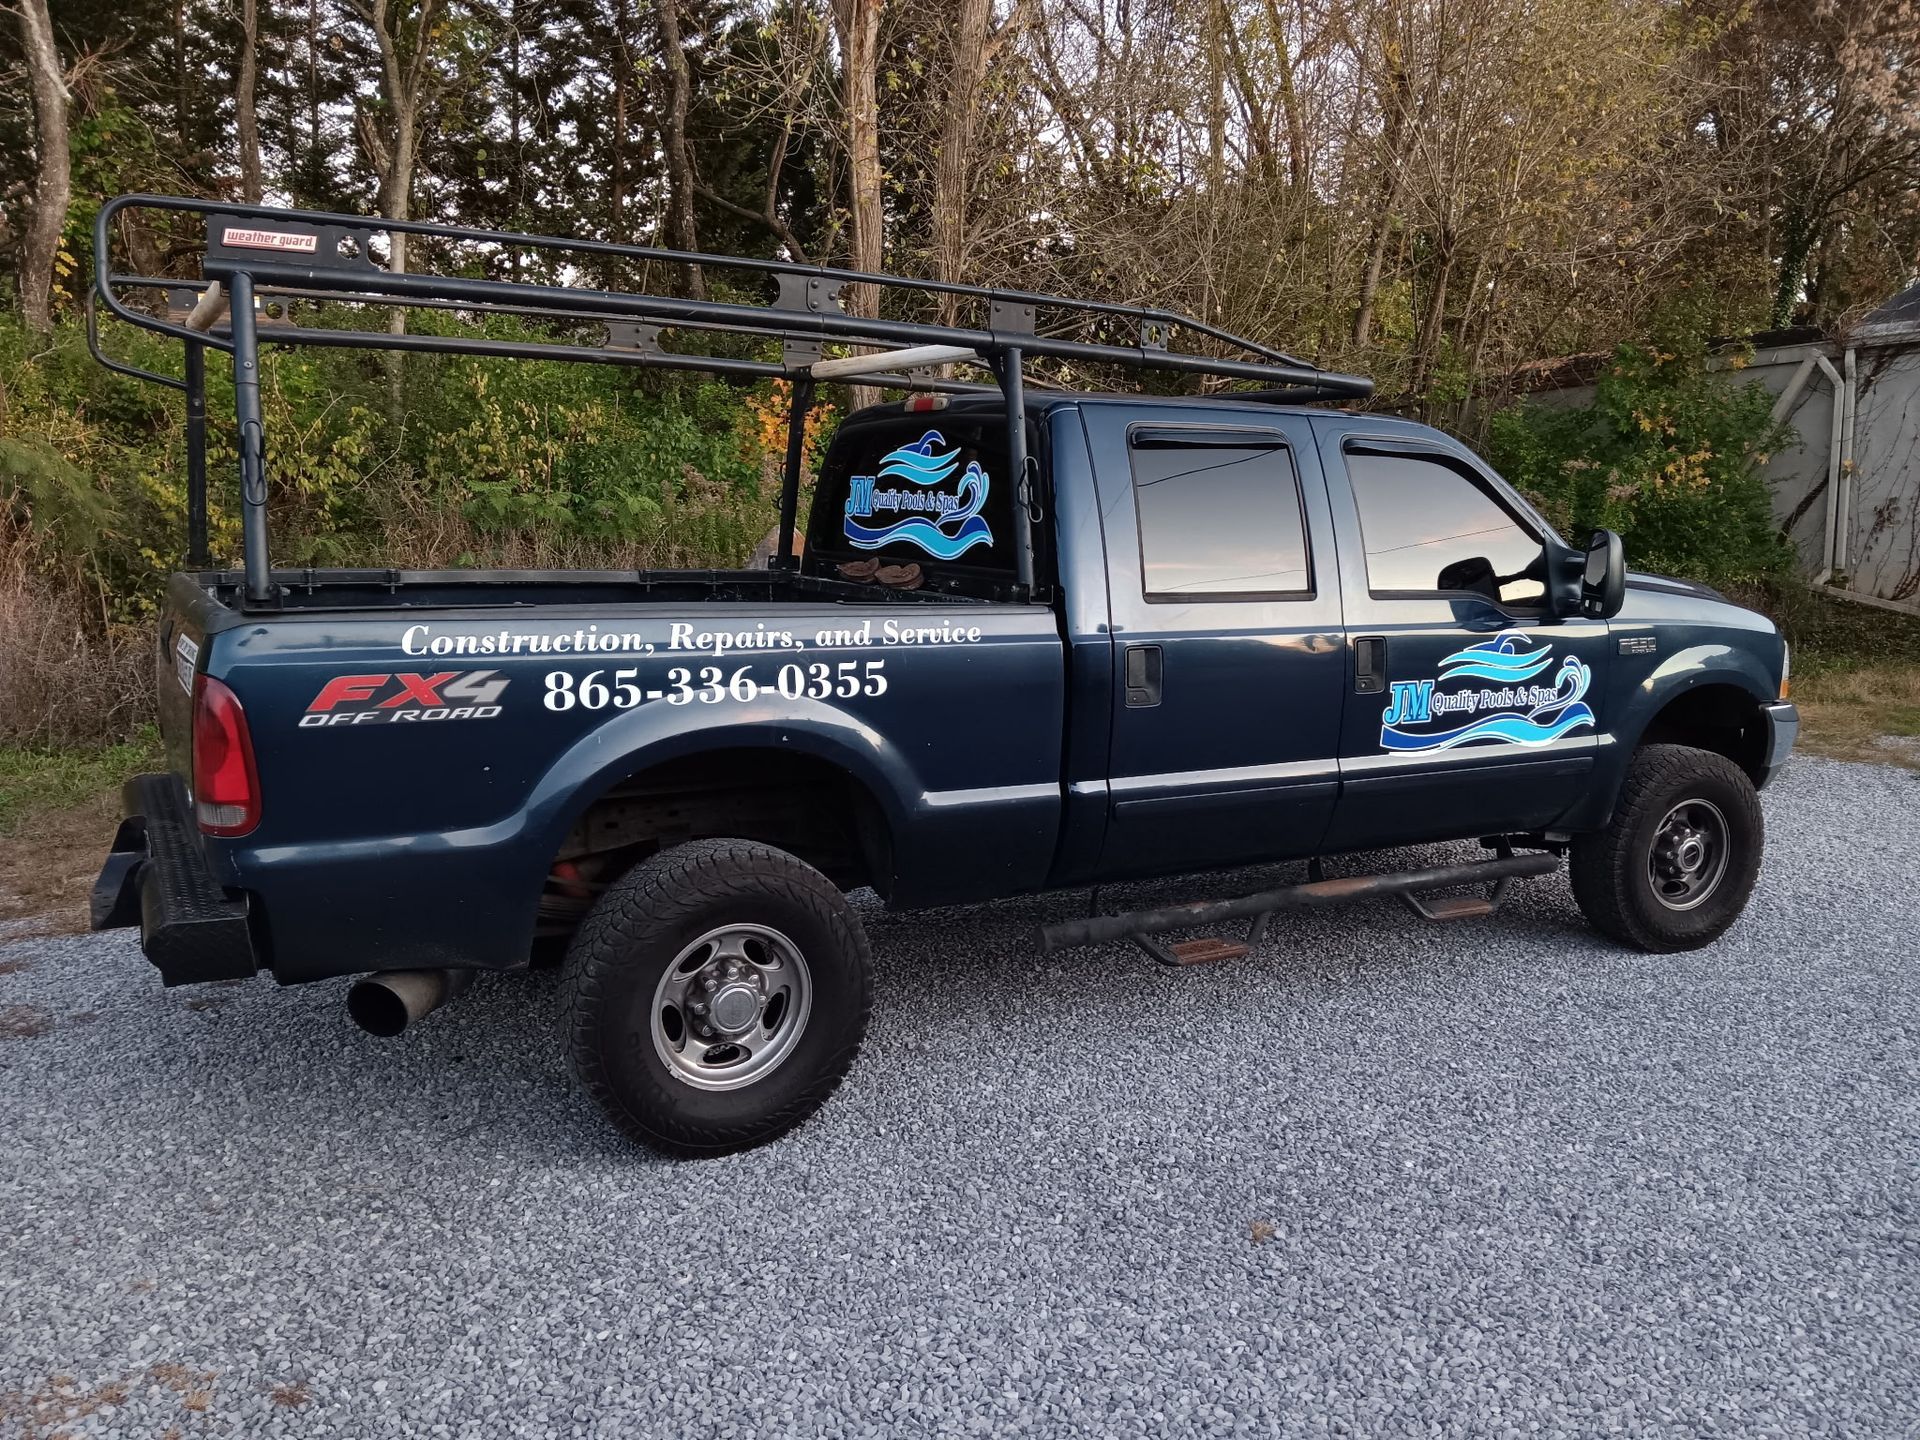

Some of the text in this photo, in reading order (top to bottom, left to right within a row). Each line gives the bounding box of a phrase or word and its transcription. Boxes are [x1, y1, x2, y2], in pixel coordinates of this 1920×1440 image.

[227, 231, 313, 247] weather guard
[845, 476, 959, 517] JM Quality Pools & Spas
[401, 619, 982, 657] Construction, Repairs, and Service
[306, 669, 512, 713] FX4
[543, 659, 888, 711] 865-336-0355
[1383, 680, 1558, 725] JM Quality Pools & Spas
[298, 705, 503, 728] OFF ROAD
